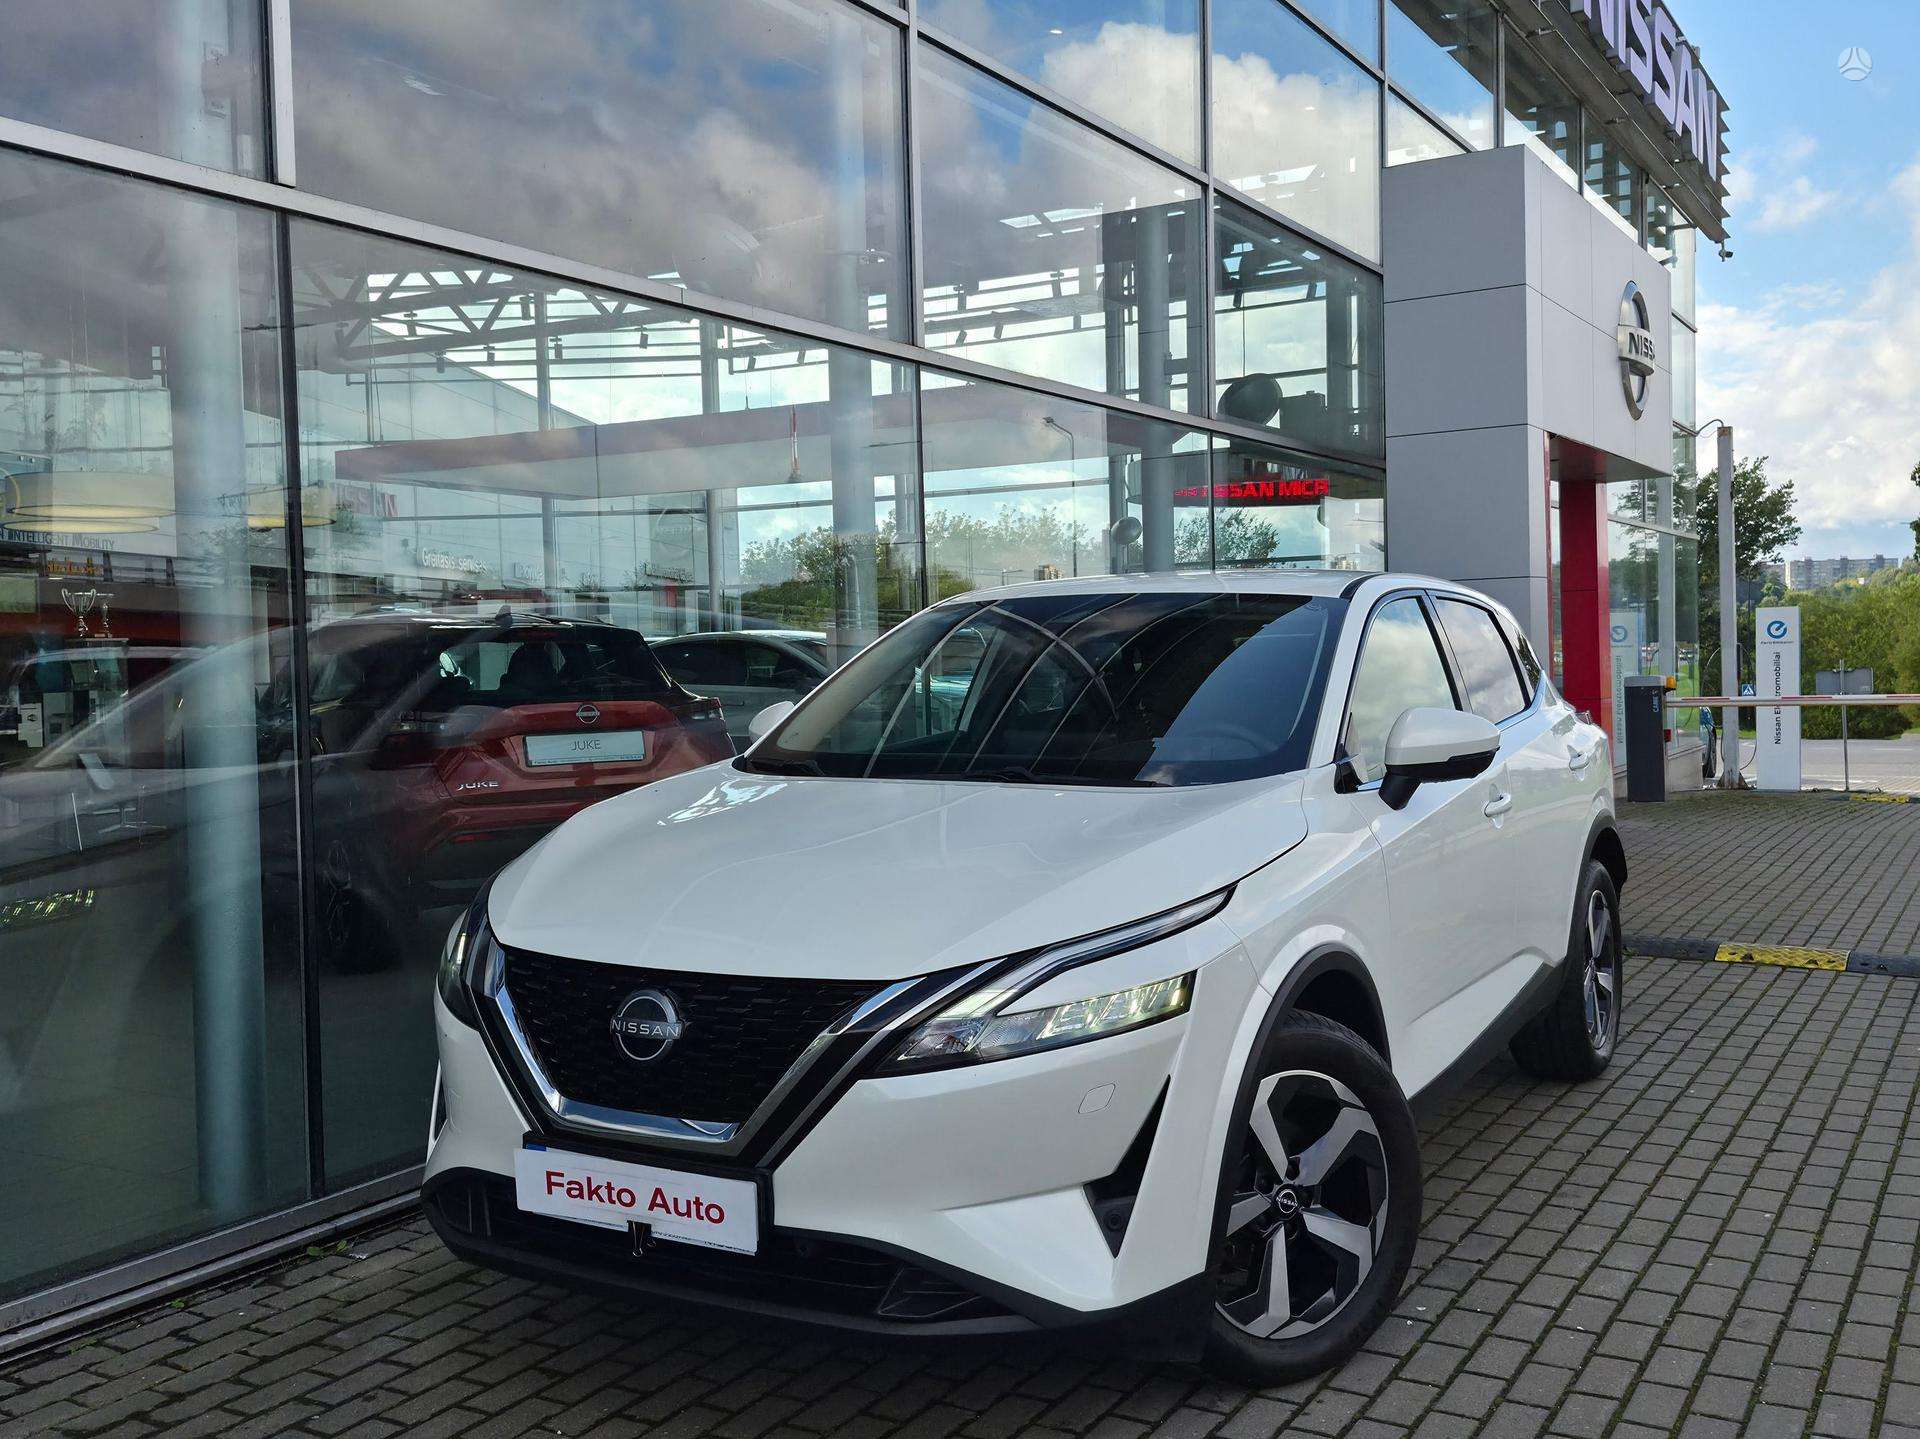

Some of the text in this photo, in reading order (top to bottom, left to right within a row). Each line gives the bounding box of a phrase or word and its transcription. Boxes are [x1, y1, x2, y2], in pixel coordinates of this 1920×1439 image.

[1773, 652, 1781, 744] Nissan Eltromobiliai
[571, 740, 602, 751] JUKE
[456, 781, 499, 791] JUKE
[612, 1019, 679, 1037] NISSAN
[545, 1170, 725, 1224] Fakto Auto
